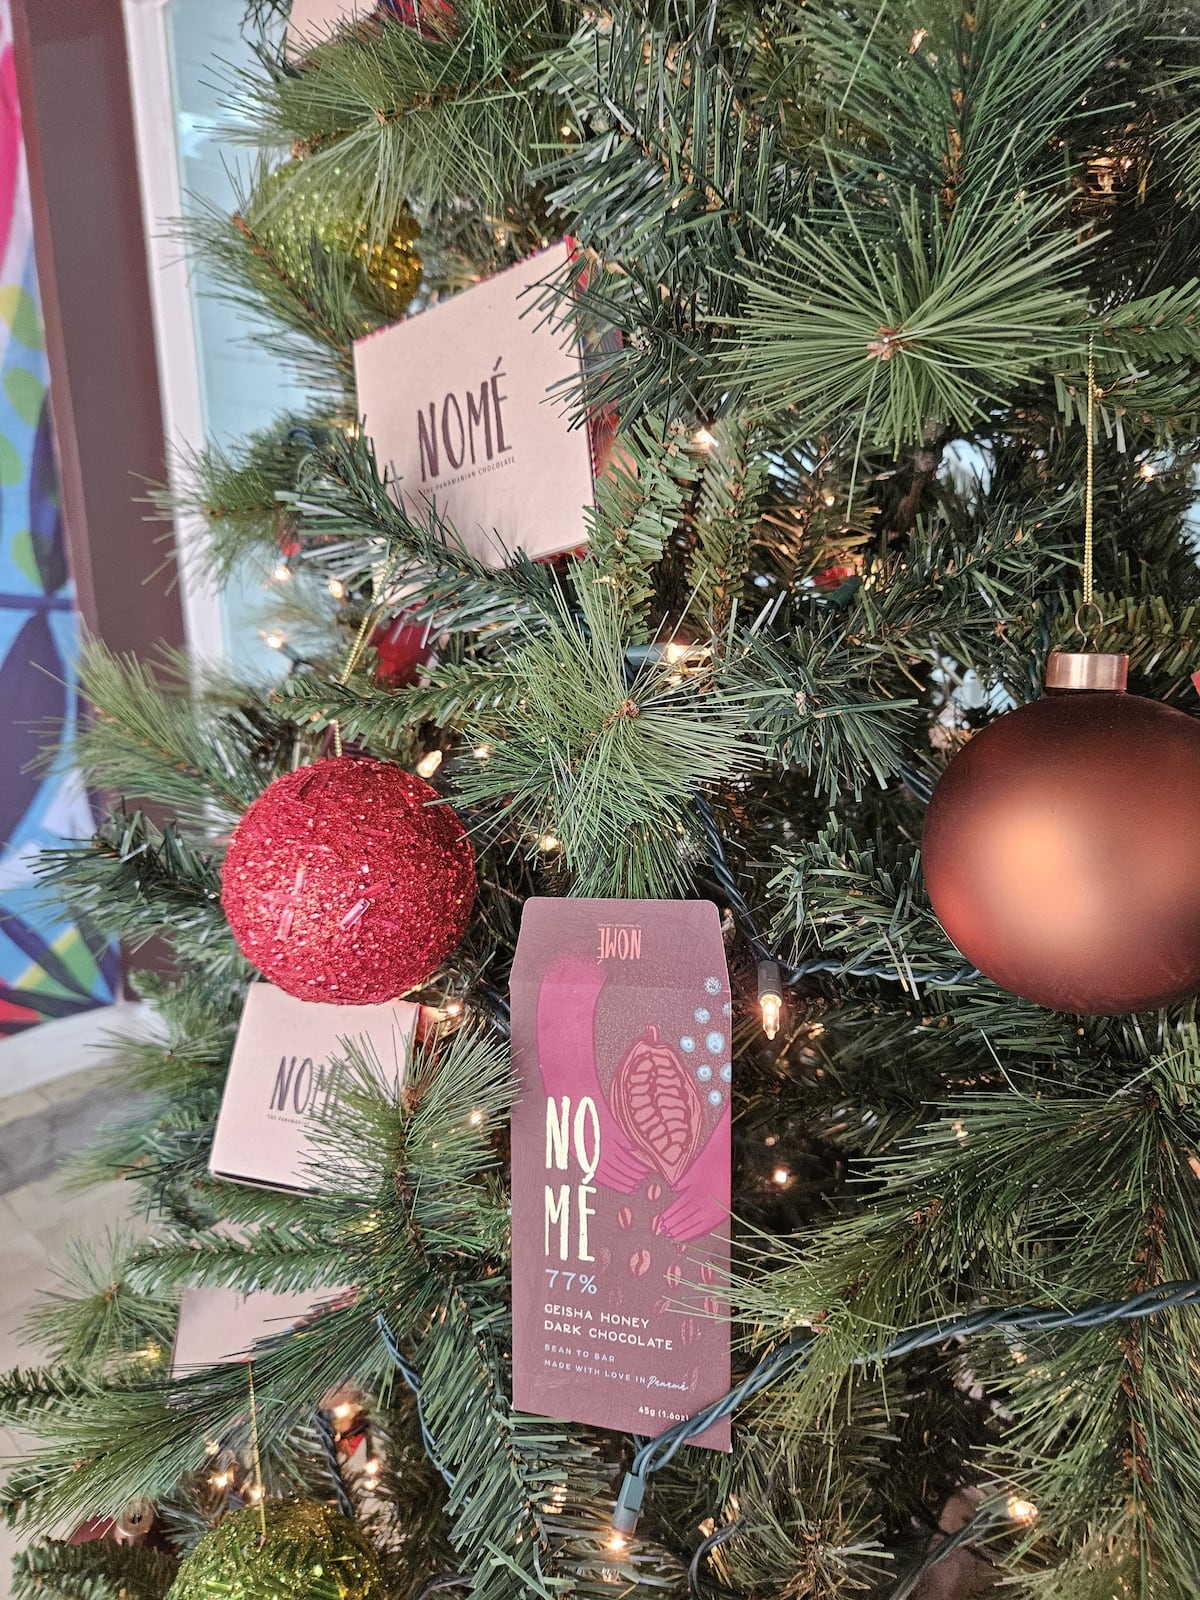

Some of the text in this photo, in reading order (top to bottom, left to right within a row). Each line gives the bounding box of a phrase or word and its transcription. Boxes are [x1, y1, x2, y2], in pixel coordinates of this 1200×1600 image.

[418, 356, 512, 482] NOMÉ
[478, 456, 515, 475] CHOCOLATE
[597, 927, 641, 965] NOMÉ
[545, 1096, 600, 1173] NO
[545, 1172, 597, 1262] MÉ
[545, 1269, 598, 1295] 77%
[544, 1303, 649, 1329] GEISHA HONEY
[544, 1320, 673, 1351] DARK CHOCOLATE
[544, 1343, 615, 1363] BEAN TO BAR
[544, 1359, 571, 1370] MADE
[575, 1364, 600, 1375] WITH
[604, 1370, 631, 1382] LOVE
[635, 1375, 646, 1384] IN
[638, 1406, 689, 1421] 45g (1.6oz)
